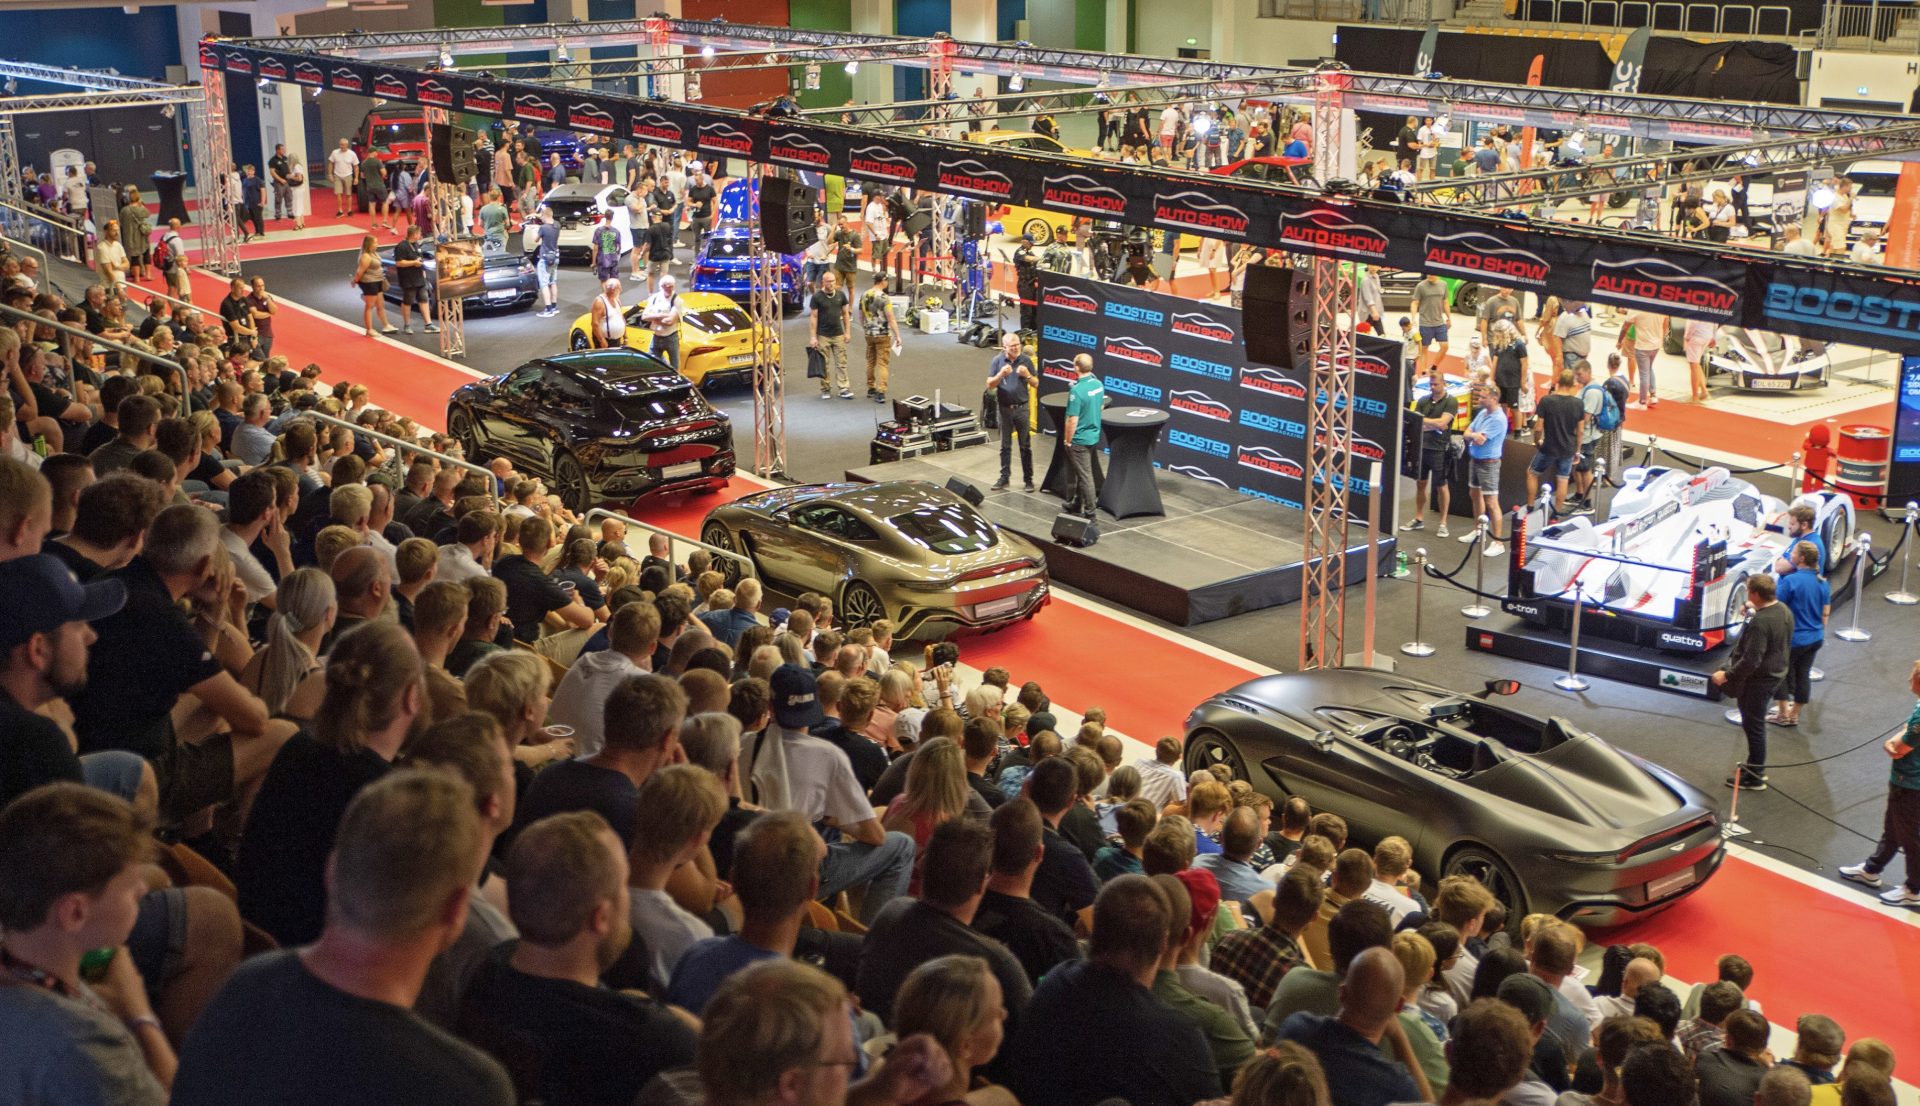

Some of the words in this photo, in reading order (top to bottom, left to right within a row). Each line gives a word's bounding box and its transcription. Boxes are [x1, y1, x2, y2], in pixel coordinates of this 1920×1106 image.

[281, 26, 290, 36] K
[1907, 62, 1918, 74] H
[262, 97, 271, 110] H
[464, 98, 481, 108] AUTO
[482, 100, 502, 111] SHOW
[516, 105, 534, 116] AUTO
[535, 108, 556, 120] SHOW
[571, 115, 590, 125] AUTO
[591, 117, 613, 129] SHOW
[633, 125, 654, 135] AUTO
[655, 128, 681, 140] SHOW
[699, 135, 722, 147] AUTO
[723, 138, 752, 153] SHOW
[771, 146, 797, 158] AUTO
[798, 150, 829, 164] SHOW
[851, 159, 880, 172] AUTO
[881, 164, 916, 179] SHOW
[940, 173, 972, 187] AUTO
[973, 178, 1012, 194] SHOW
[1044, 188, 1081, 203] AUTO
[1082, 193, 1127, 212] SHOW
[1155, 206, 1197, 222] AUTO
[1198, 212, 1248, 231] SHOW
[1282, 225, 1329, 244] AUTO
[1330, 232, 1387, 252] SHOW
[1360, 250, 1387, 259] DENMARK
[1427, 248, 1482, 267] AUTO
[1483, 256, 1548, 280] SHOW
[1516, 276, 1547, 287] DENMARK
[1594, 274, 1658, 297] AUTO
[1659, 284, 1736, 310] SHOW
[1045, 294, 1068, 306] AUTO
[1069, 299, 1097, 312] SHOW
[1104, 302, 1164, 323] BOOSTED
[1698, 305, 1734, 317] DENMARK
[1764, 282, 1920, 329] BOOST
[1043, 325, 1097, 346] BOOSTED
[1173, 321, 1201, 334] AUTO
[1202, 327, 1233, 341] SHOW
[1106, 345, 1130, 357] AUTO
[1131, 350, 1161, 364] SHOW
[1044, 367, 1068, 378] AUTO
[1170, 354, 1233, 377] BOOSTED
[1354, 359, 1389, 375] SHOW
[1104, 376, 1162, 398] BOOSTED
[1242, 376, 1270, 390] AUTO
[1271, 382, 1305, 398] SHOW
[1171, 398, 1198, 412] AUTO
[1199, 404, 1231, 420] SHOW
[1240, 410, 1306, 434] BOOSTED
[1168, 429, 1231, 454] BOOSTED
[1350, 442, 1384, 459] SHOW
[1240, 454, 1268, 468] AUTO
[1269, 461, 1302, 478] SHOW
[1507, 603, 1538, 615] e-tron
[1661, 633, 1704, 647] quattro
